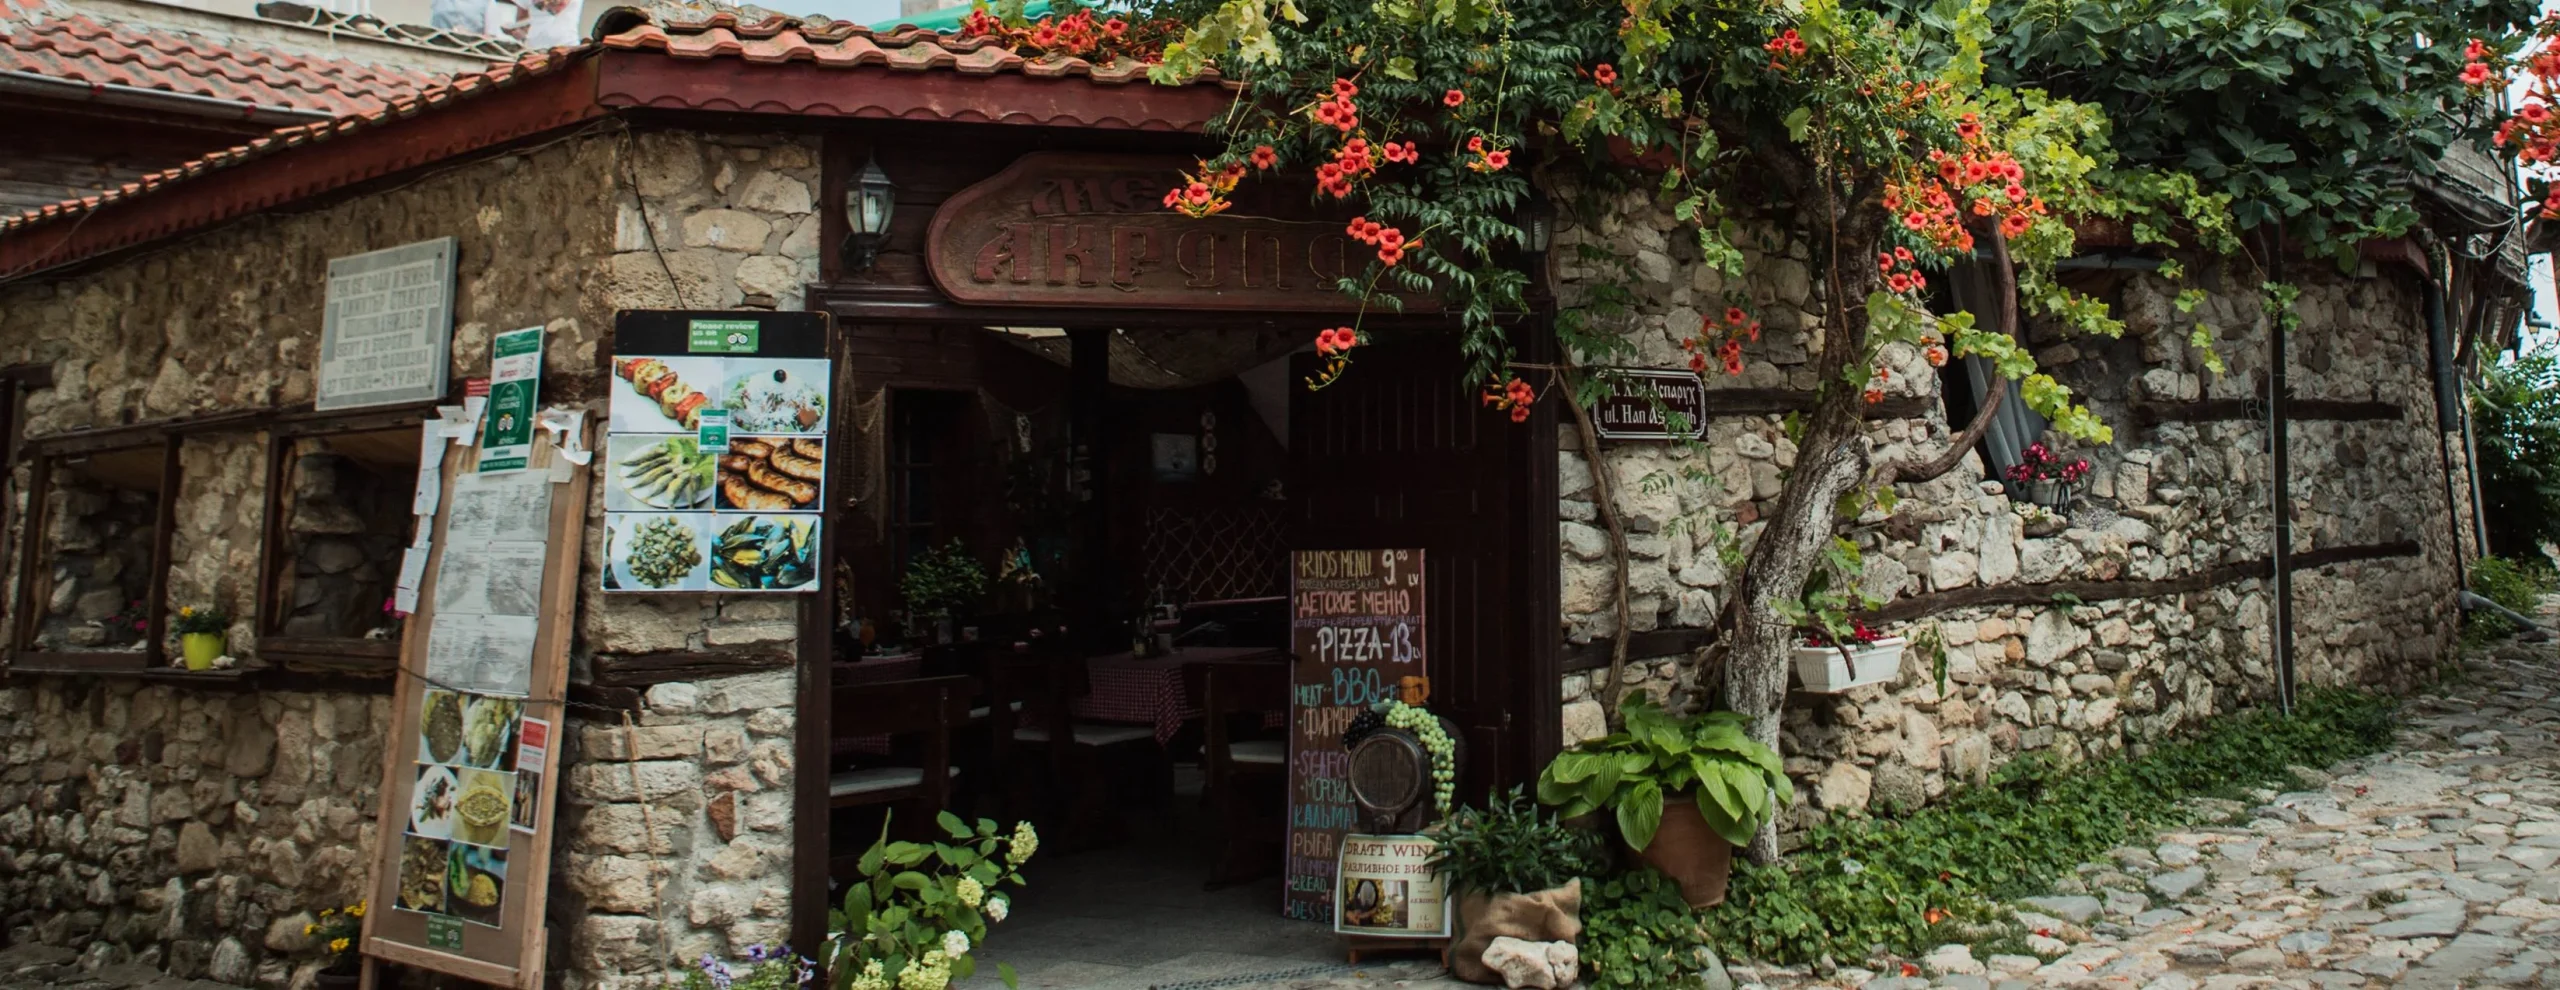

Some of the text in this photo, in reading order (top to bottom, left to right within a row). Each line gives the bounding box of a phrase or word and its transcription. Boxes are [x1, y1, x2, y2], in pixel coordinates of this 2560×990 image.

[974, 221, 1360, 292] АКРОПО
[692, 322, 757, 330] Please review
[1604, 404, 1619, 424] ul.
[1622, 404, 1646, 424] Han
[1301, 550, 1338, 578] KIDS
[1340, 550, 1372, 578] MENU
[1299, 588, 1410, 618] ДЕТСКОЕ МЕНЮ
[1299, 750, 1348, 778] SEAFO
[1305, 777, 1355, 803] МОРСКИ
[1293, 803, 1358, 830] КАЛЬМА
[1293, 832, 1333, 858] РЫБА
[1345, 842, 1387, 857] DRAFT
[1343, 862, 1433, 874] РАЗЛИВНОЕ ВИН
[1291, 900, 1333, 924] DESSE
